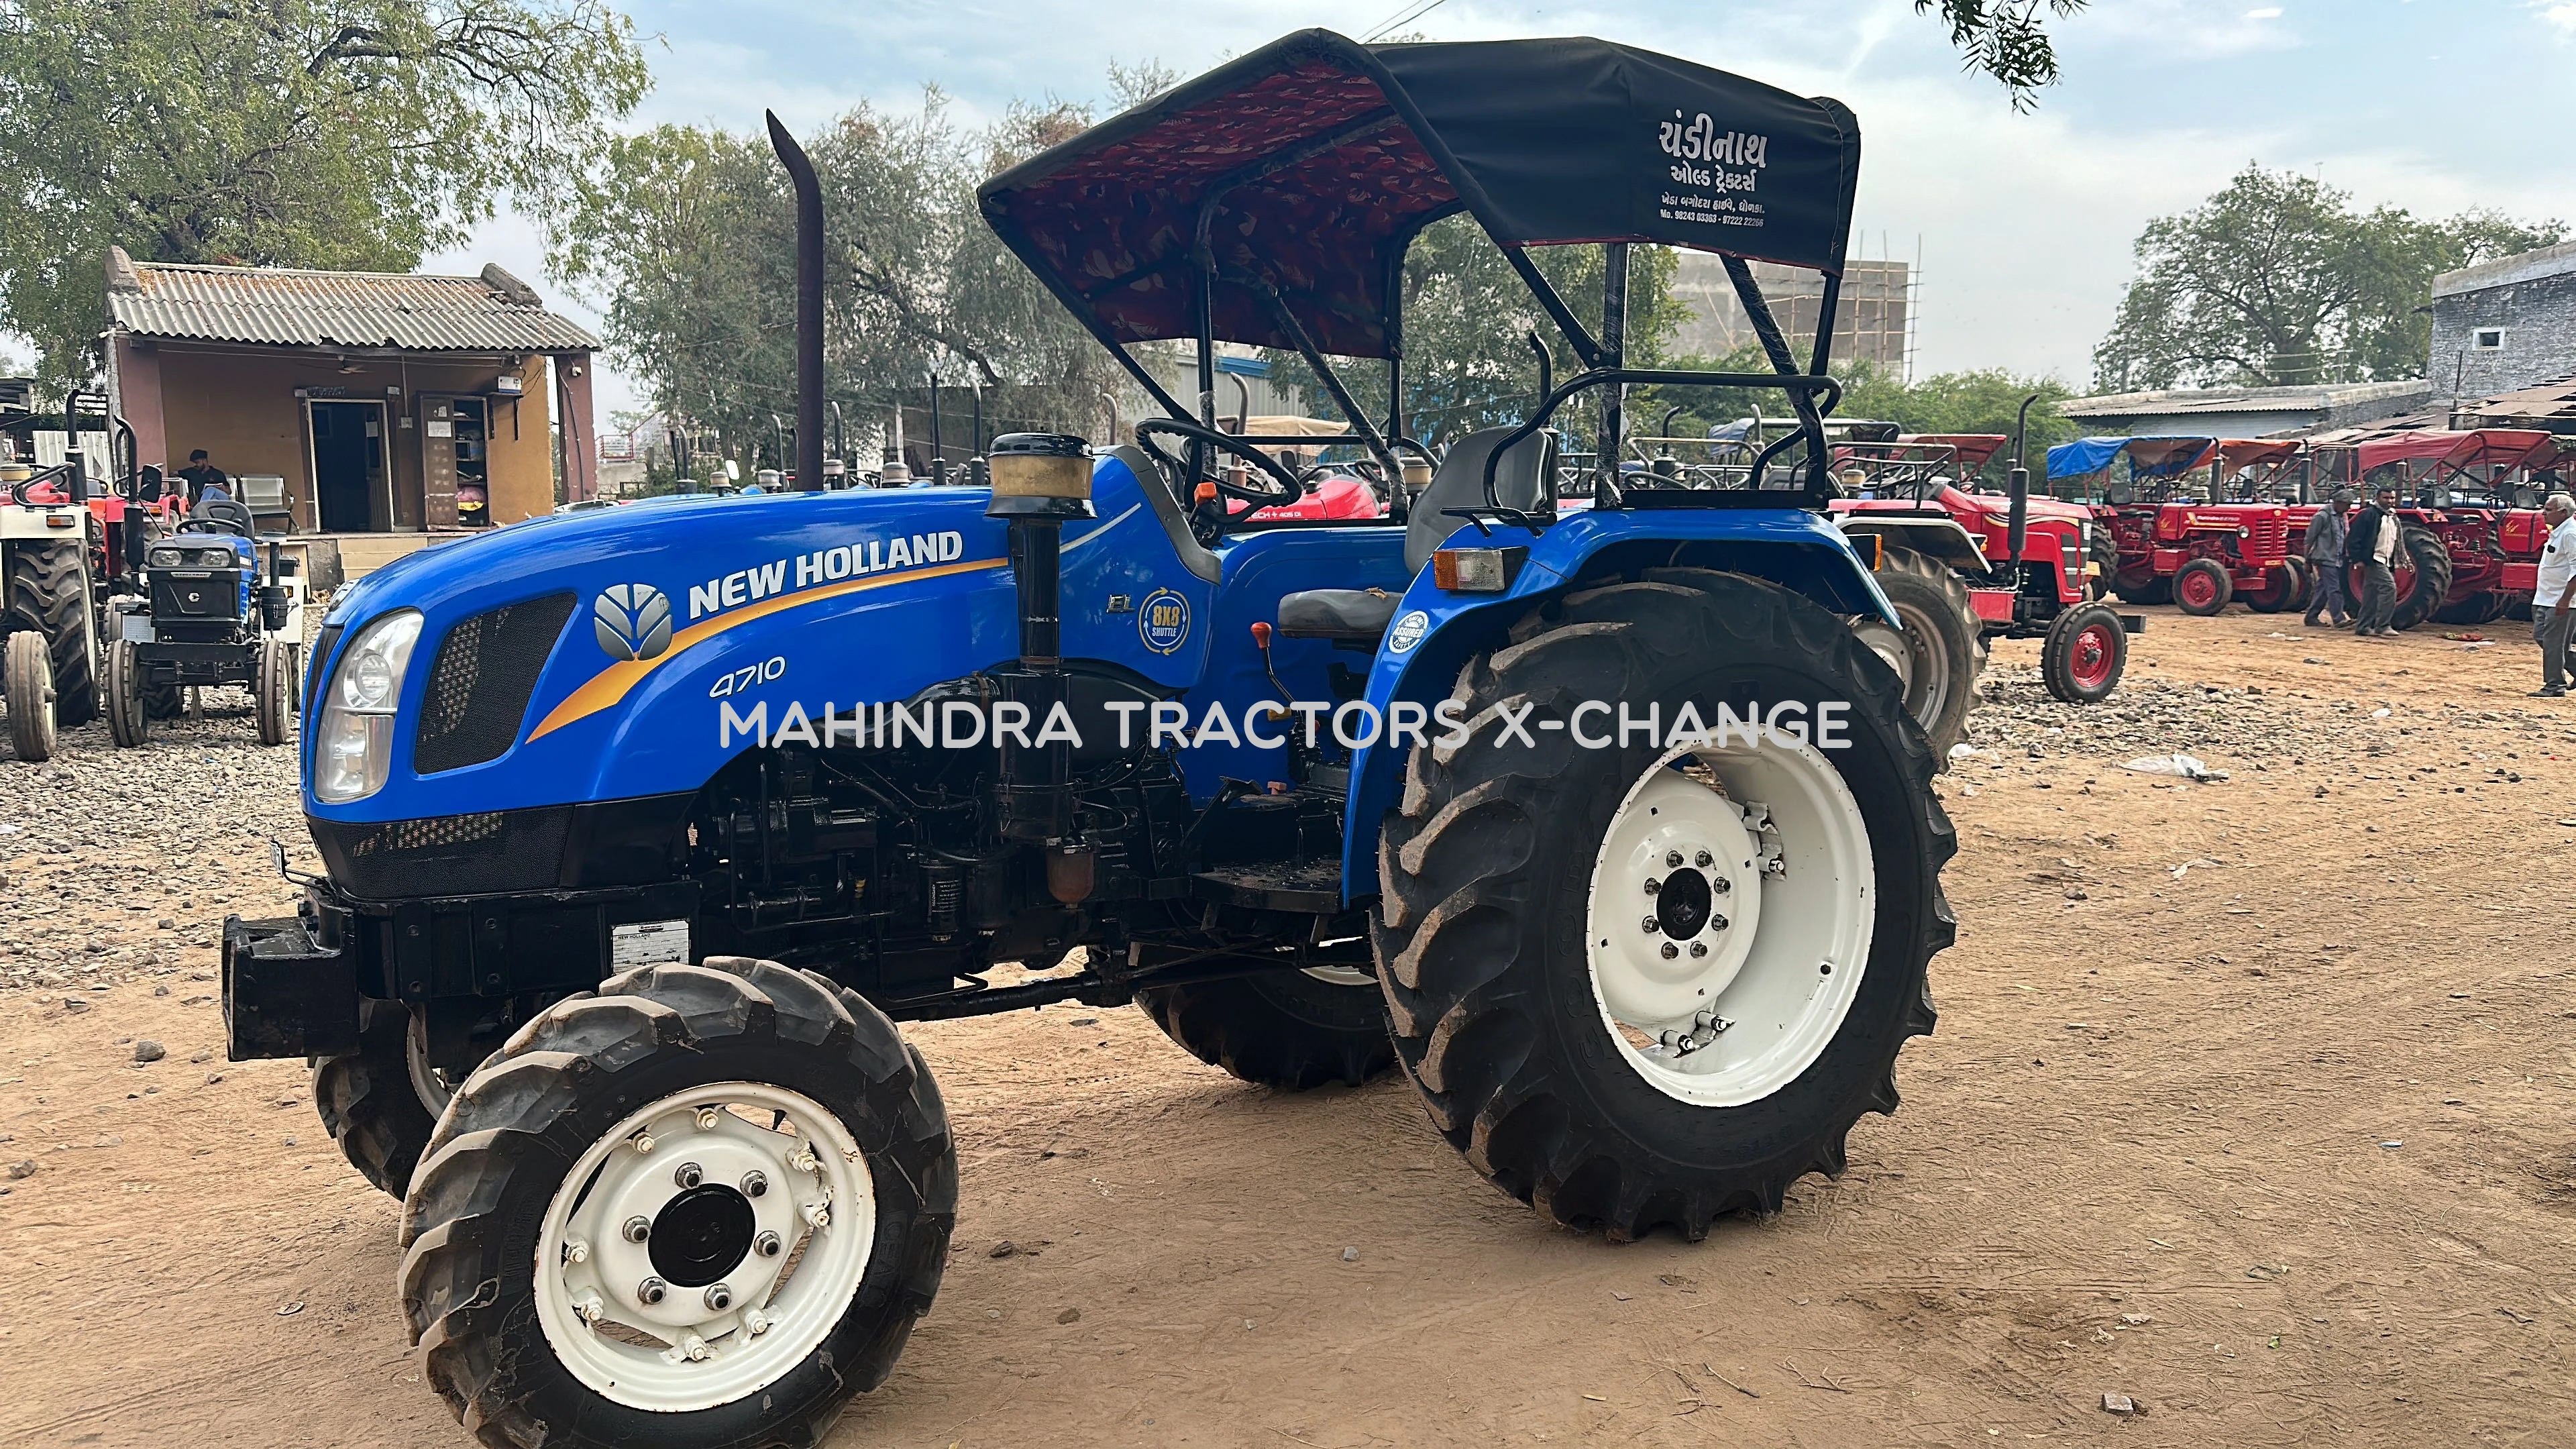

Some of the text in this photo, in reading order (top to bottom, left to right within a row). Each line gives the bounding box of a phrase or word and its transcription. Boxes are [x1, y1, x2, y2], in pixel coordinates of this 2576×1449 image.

[1659, 109, 1768, 168] ચંડીનાથ
[1670, 160, 1711, 186] ઓલ્ડ
[1675, 211, 1695, 221] 98243
[1723, 215, 1742, 225] 97222
[690, 531, 963, 619] NEW HOLLAND
[1152, 605, 1181, 627] 8X8
[1152, 627, 1177, 637] SHUTTLE
[1391, 626, 1425, 639] ASSURED
[709, 656, 786, 698] 4710
